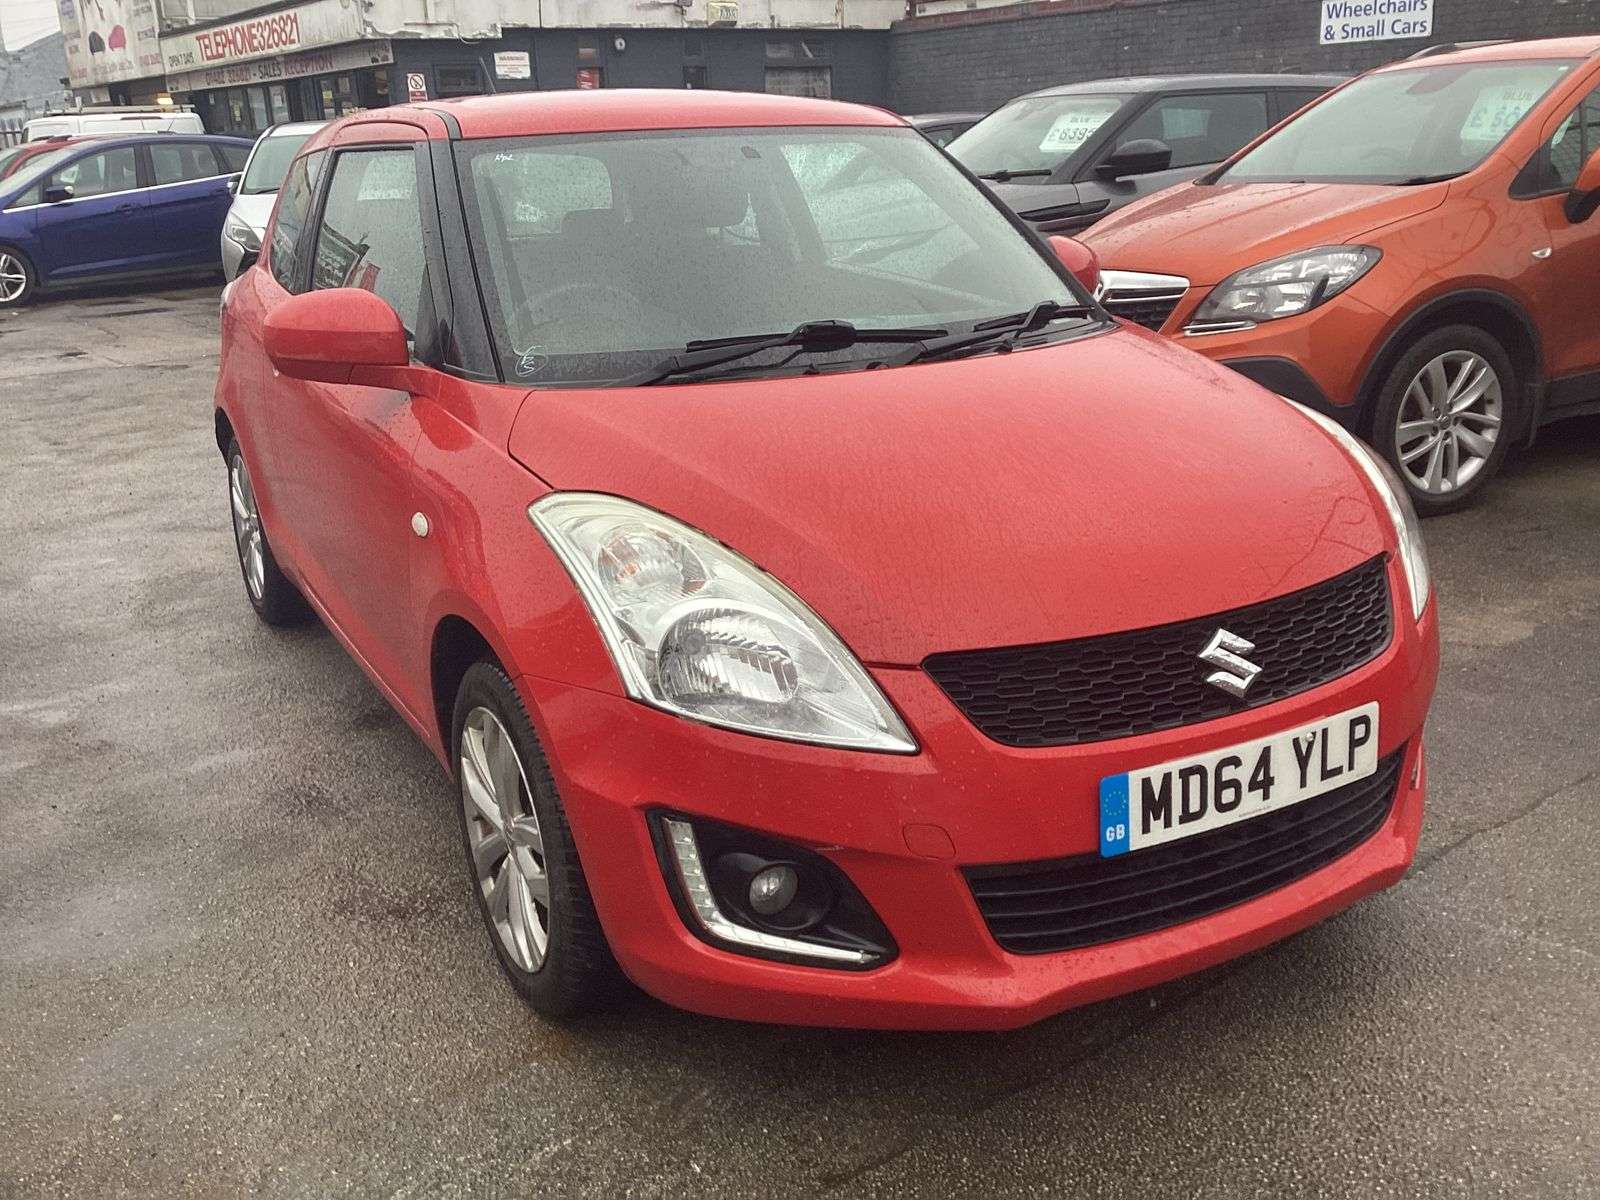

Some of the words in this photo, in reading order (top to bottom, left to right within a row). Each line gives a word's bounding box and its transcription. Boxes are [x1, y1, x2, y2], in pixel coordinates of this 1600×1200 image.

[1326, 0, 1428, 19] Wheelchairs
[1324, 24, 1335, 41] &
[1341, 19, 1385, 40] Small
[1391, 18, 1427, 35] Cars
[258, 61, 282, 79] SALES
[284, 54, 336, 76] RECEPTION
[1141, 745, 1275, 835] MD64
[1292, 714, 1371, 789] YLP
[1106, 824, 1125, 842] GB
